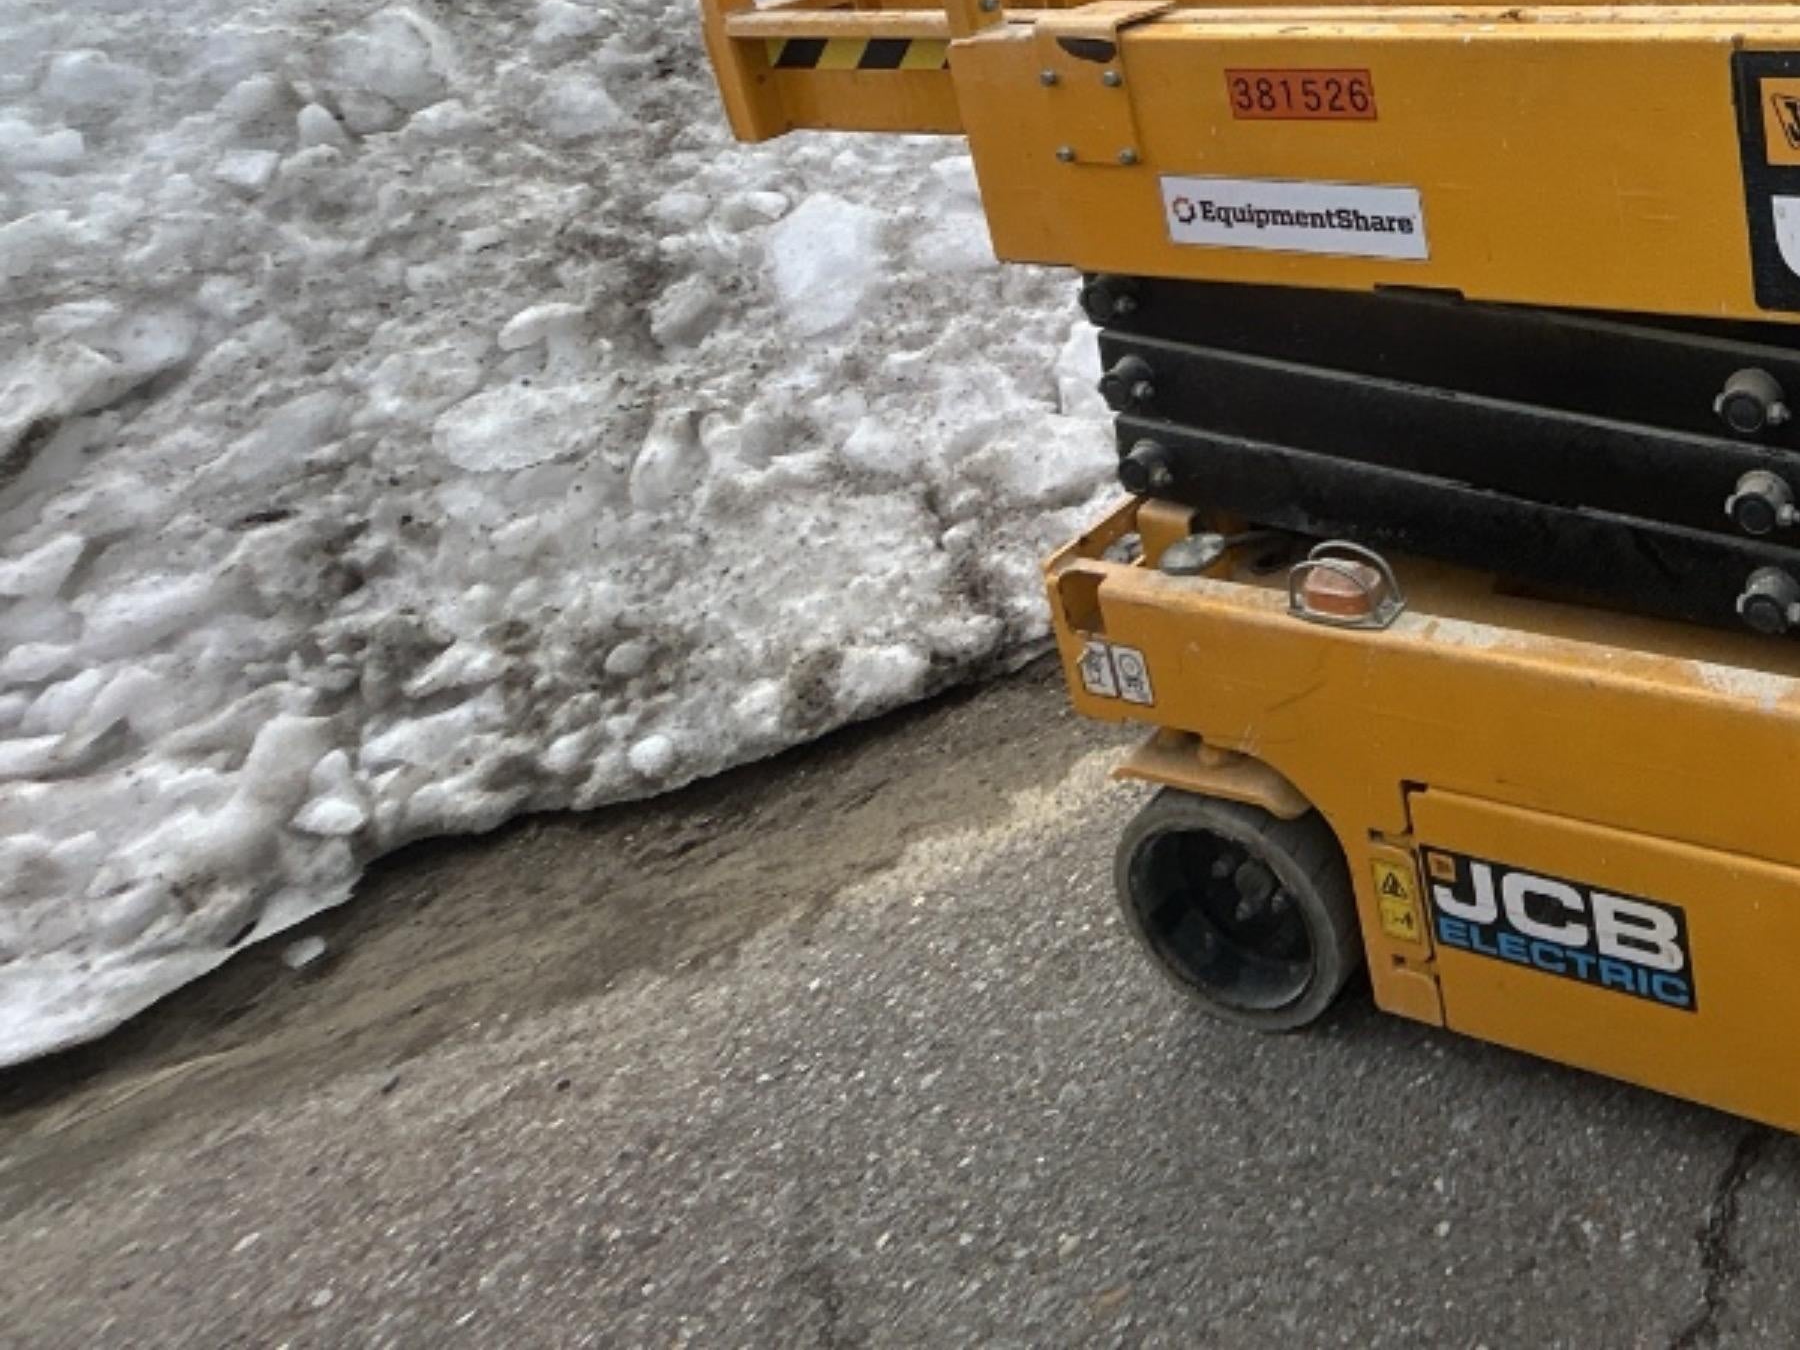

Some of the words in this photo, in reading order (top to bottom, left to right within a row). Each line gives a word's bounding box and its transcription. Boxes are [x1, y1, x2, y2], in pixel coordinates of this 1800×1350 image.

[1232, 76, 1370, 113] 381526
[1199, 199, 1415, 235] EquipmentShare
[1432, 861, 1686, 973] JCB
[1438, 915, 1691, 1007] ELECTRIC
